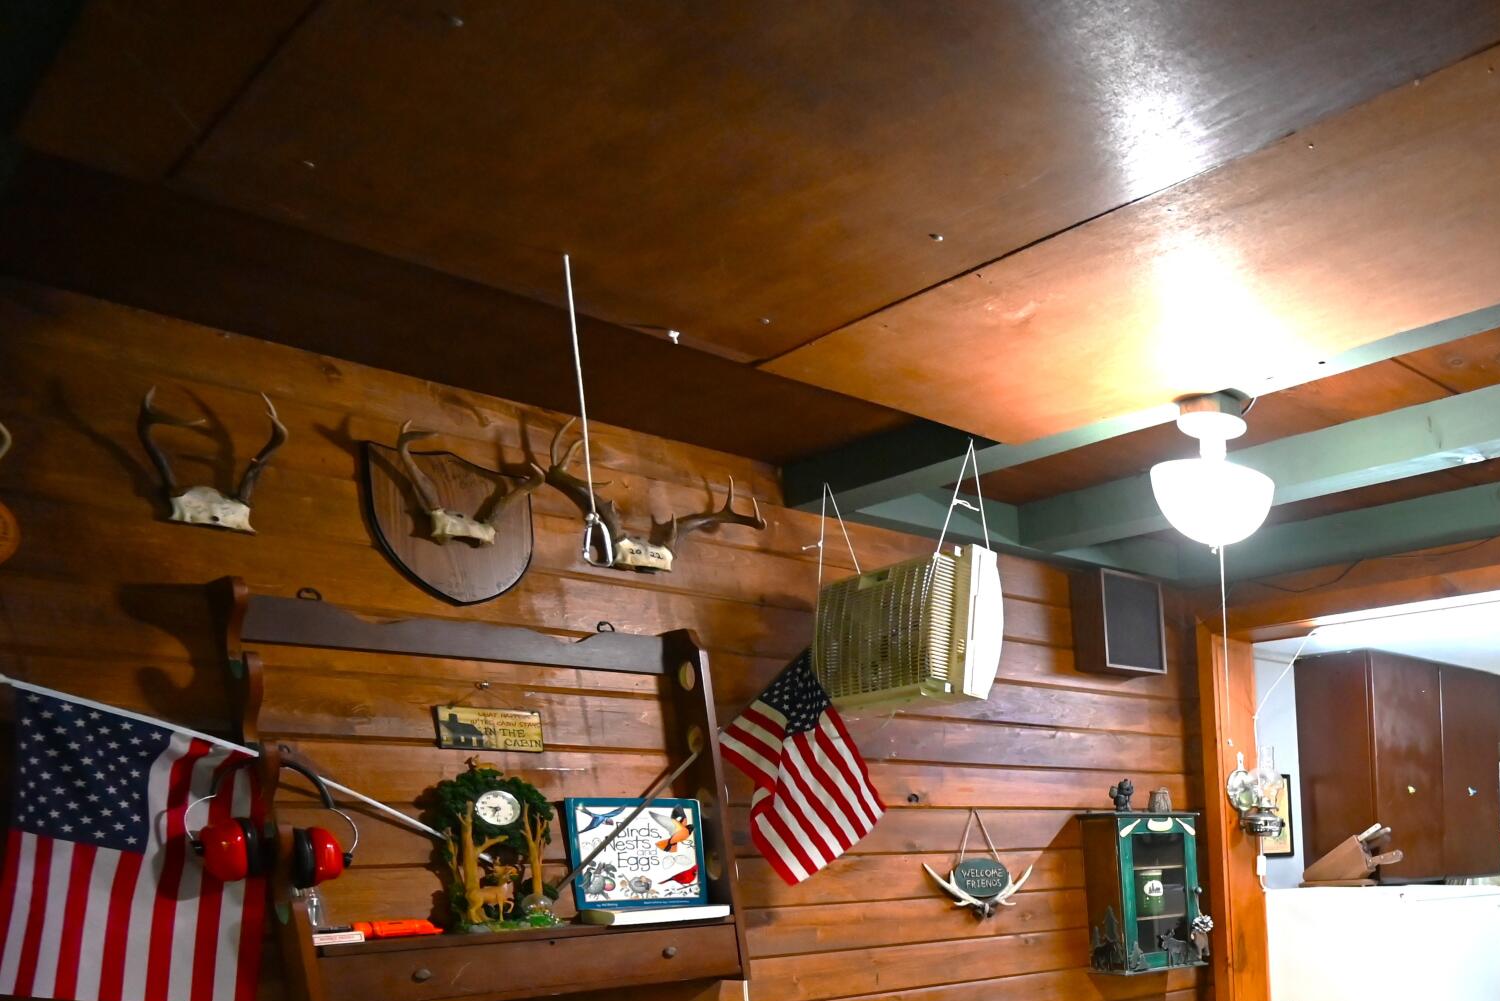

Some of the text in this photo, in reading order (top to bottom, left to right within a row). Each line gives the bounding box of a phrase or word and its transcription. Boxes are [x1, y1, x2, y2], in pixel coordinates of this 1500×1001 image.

[484, 727, 526, 738] IN THE
[504, 738, 542, 748] CABIN
[604, 836, 651, 852] Nests
[637, 847, 658, 856] and
[617, 851, 660, 872] Eggs
[961, 868, 1004, 878] WELCOME
[966, 879, 1002, 889] FRIENDS
